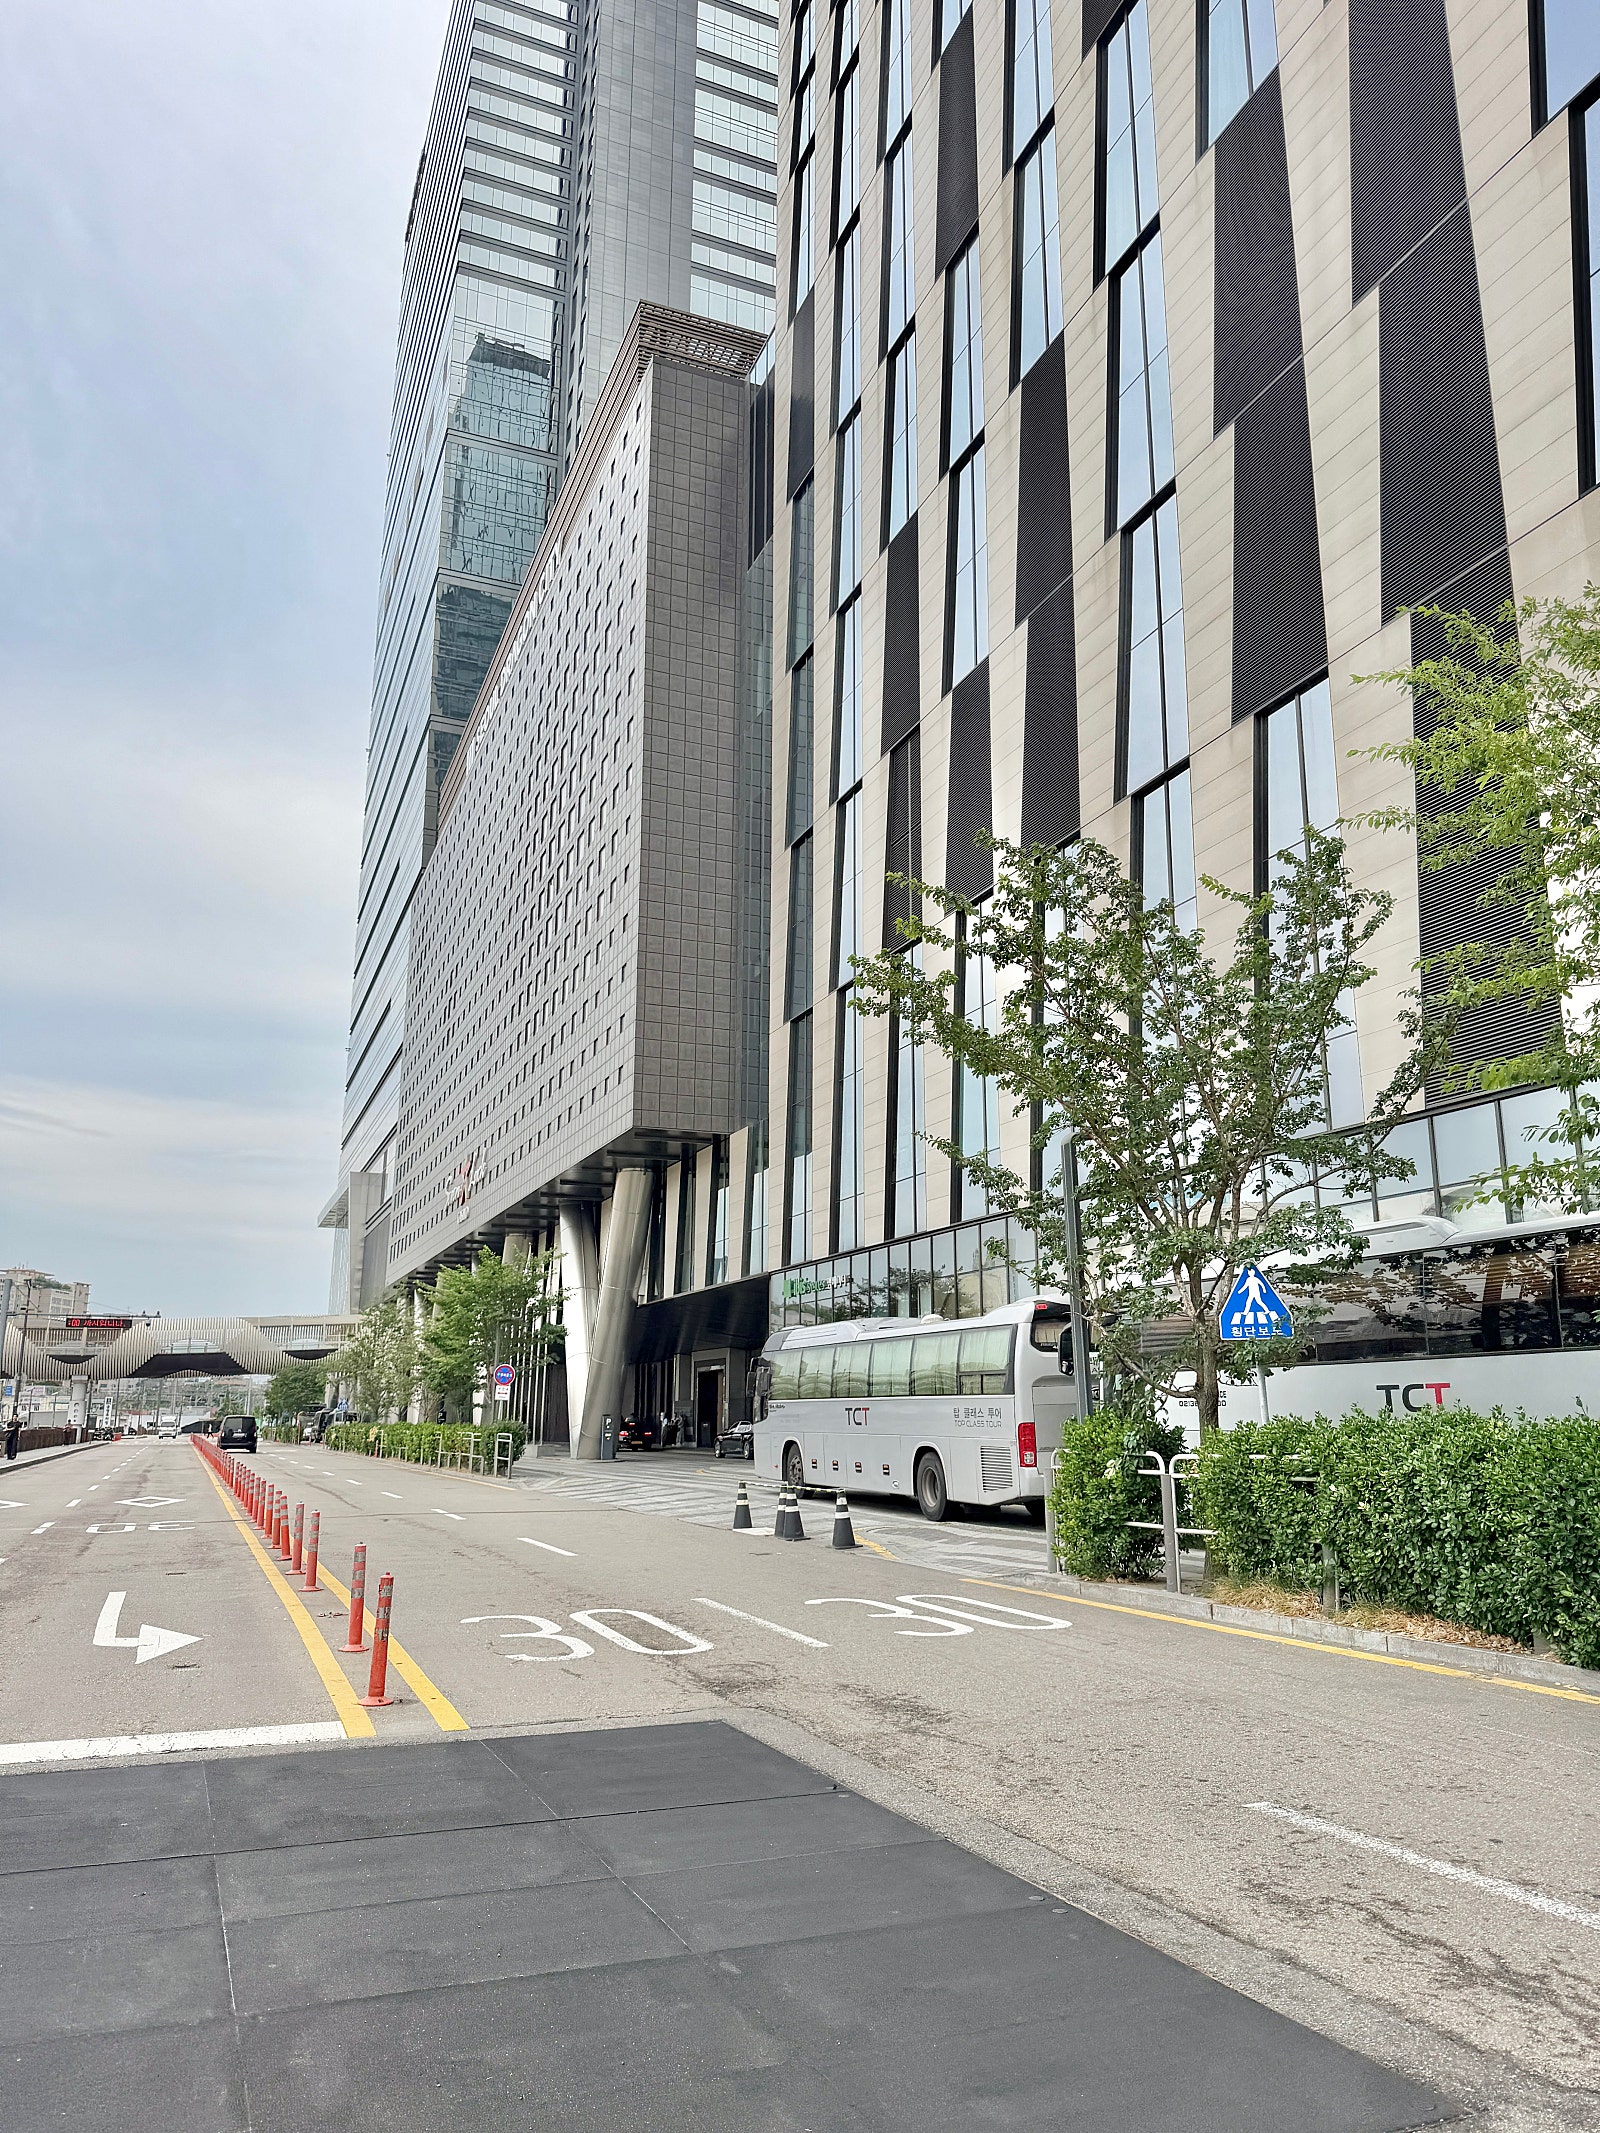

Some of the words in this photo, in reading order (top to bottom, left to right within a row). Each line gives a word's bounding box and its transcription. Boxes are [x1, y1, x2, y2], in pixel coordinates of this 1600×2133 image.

[1376, 1383, 1450, 1412] TCT
[606, 1418, 612, 1426] P
[845, 1408, 869, 1426] TCT
[954, 1408, 959, 1418] 탑
[964, 1408, 984, 1418] 클래스
[988, 1408, 1001, 1419] 투어
[805, 1595, 1072, 1636] 30
[460, 1609, 714, 1661] 30
